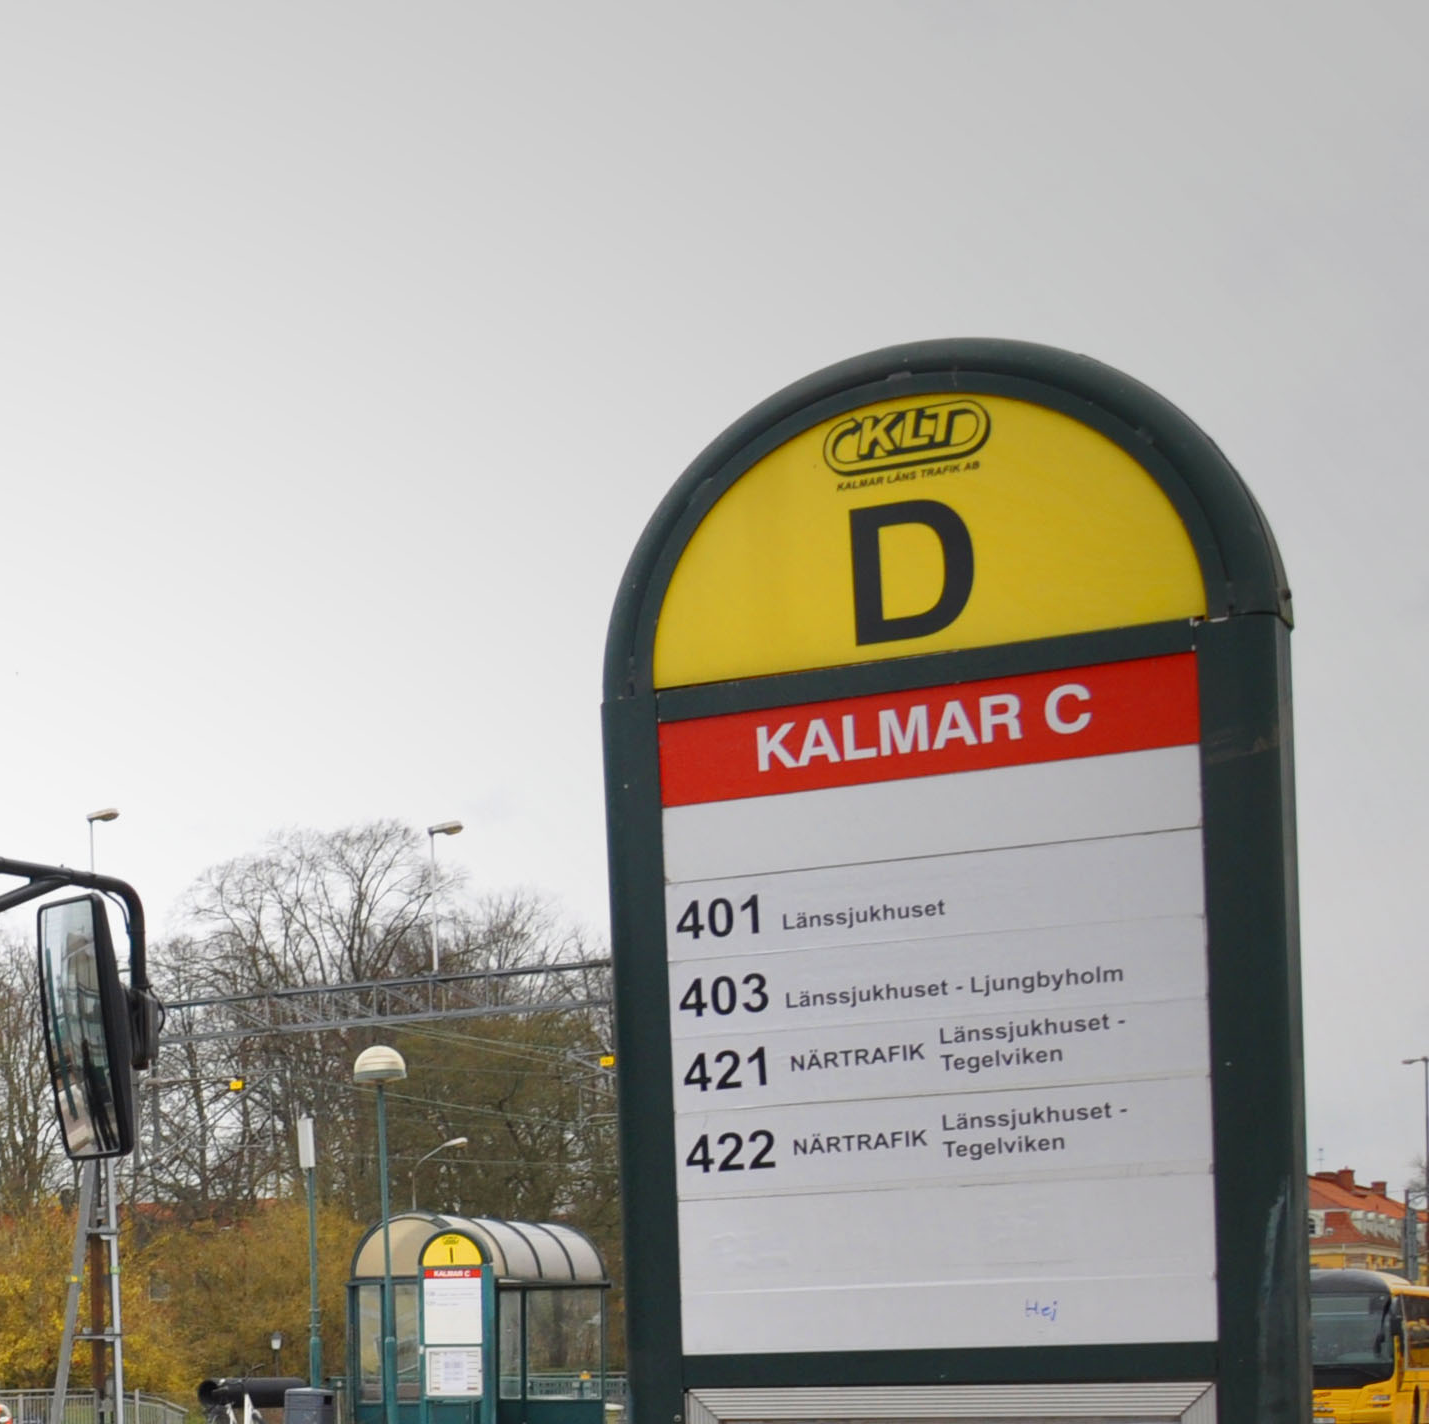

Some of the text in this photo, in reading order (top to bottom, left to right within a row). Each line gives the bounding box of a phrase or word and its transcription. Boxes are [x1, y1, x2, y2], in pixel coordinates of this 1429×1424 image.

[837, 461, 980, 492] KALMAR LÄNS TRAFIK AB
[849, 499, 974, 646] D
[754, 683, 1092, 773] KALMAR C
[676, 894, 946, 939] 401 Länssjukhuset
[679, 973, 770, 1018] 403
[786, 978, 949, 1010] Länssjukhuset
[970, 965, 1124, 996] Ljungbyholm
[939, 1012, 1111, 1045] Länssjukhuset
[683, 1042, 926, 1093] 421 NÄRTRAFIK
[941, 1045, 1063, 1075] Tegelviken
[941, 1102, 1112, 1131] Länssjukhuset
[686, 1128, 928, 1174] 422 NÄRTRAFIK
[942, 1133, 1065, 1162] Tegelviken
[433, 1269, 471, 1278] KALMAR C
[1025, 1300, 1058, 1321] Hej
